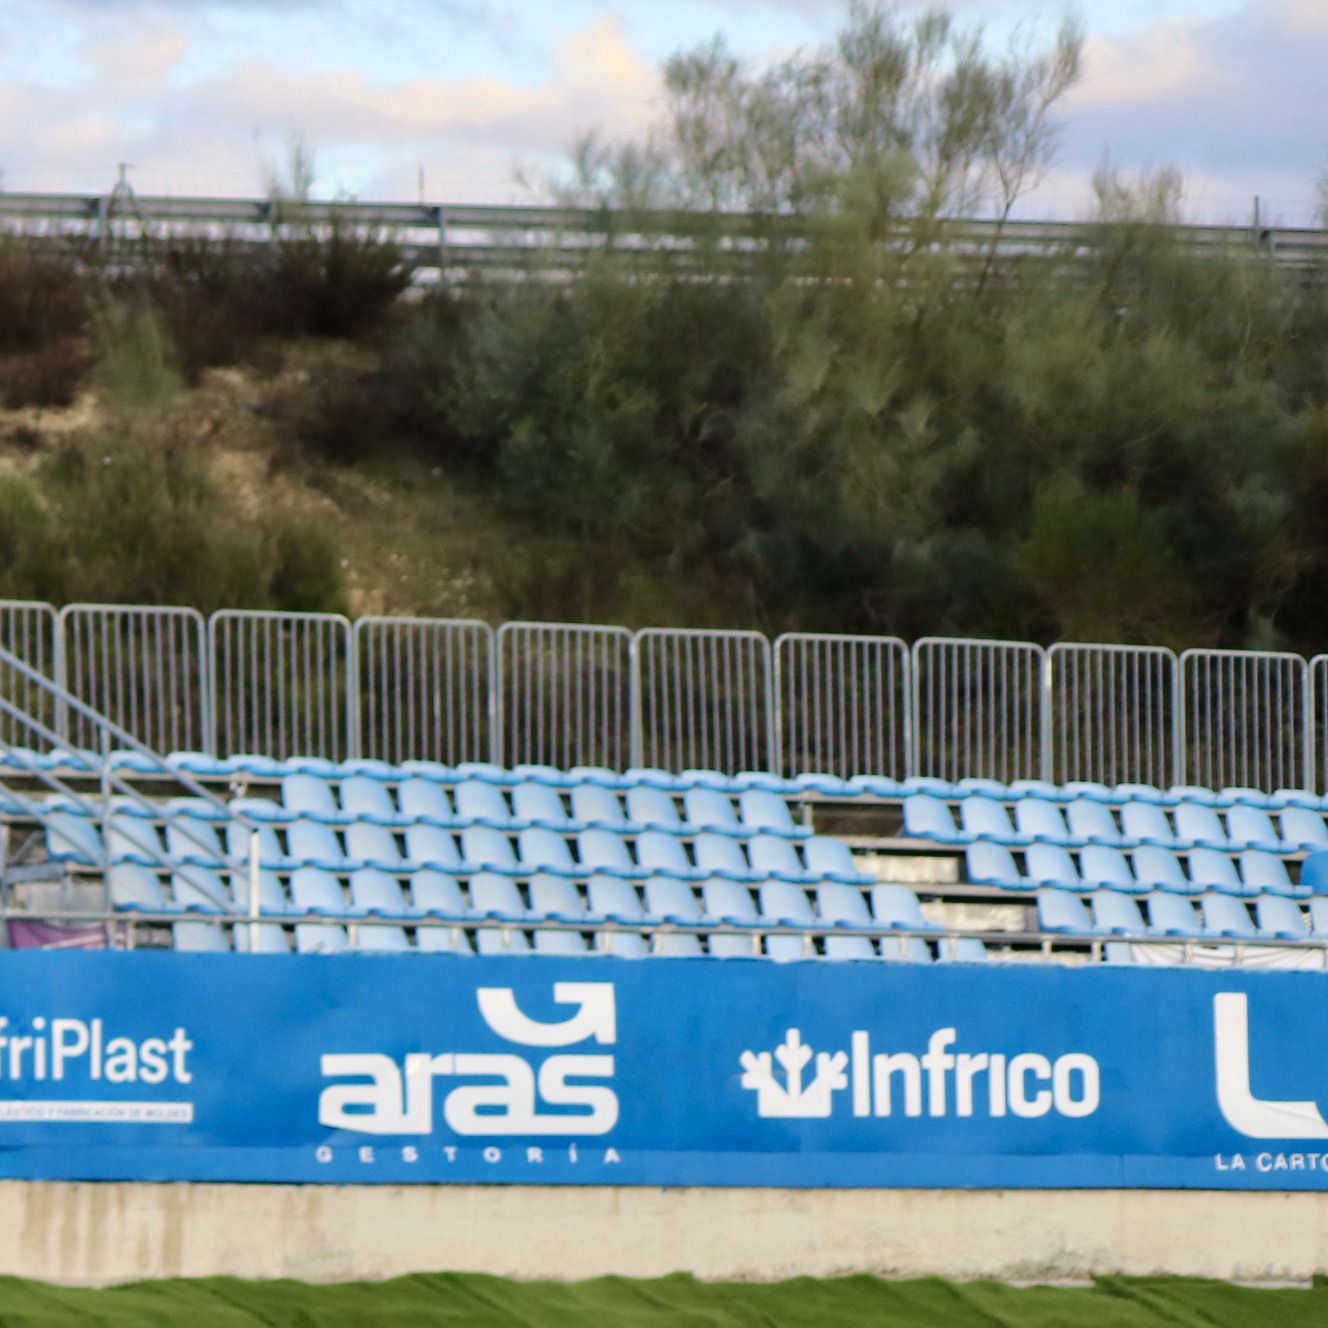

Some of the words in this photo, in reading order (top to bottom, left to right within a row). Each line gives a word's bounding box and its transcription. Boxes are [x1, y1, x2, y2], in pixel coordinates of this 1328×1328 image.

[318, 1052, 620, 1136] aras
[851, 1027, 1100, 1118] Infrico
[315, 1142, 621, 1164] GESTORÍA
[1215, 1153, 1246, 1171] LA
